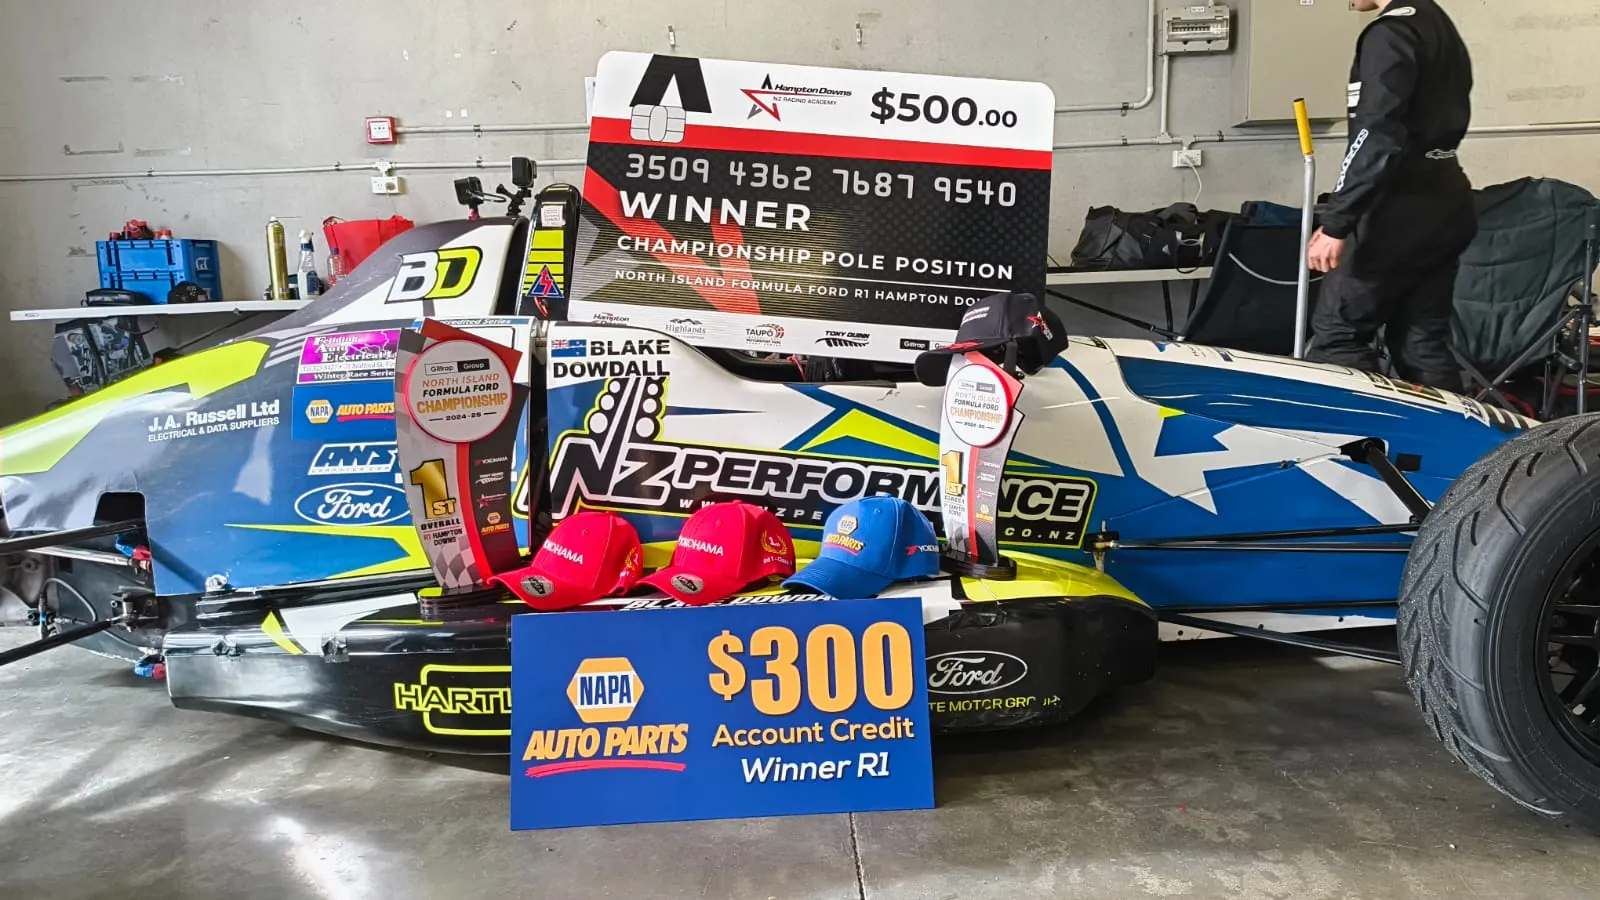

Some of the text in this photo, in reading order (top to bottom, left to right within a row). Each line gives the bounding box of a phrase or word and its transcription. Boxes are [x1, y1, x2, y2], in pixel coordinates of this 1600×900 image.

[774, 84, 852, 97] Hampton Downs
[870, 86, 1018, 128] $500.00
[626, 153, 1016, 207] 3509 4362 7687 9540
[619, 190, 811, 232] WINNER
[617, 235, 1013, 280] CHAMPIONSHIP POLE POSITION
[385, 246, 483, 304] BD
[615, 269, 665, 283] NORTH
[671, 273, 726, 288] ISLAND
[731, 278, 803, 294] FORMULA
[808, 285, 849, 298] FORD
[854, 289, 869, 299] R1
[875, 291, 949, 305] HAMPTON
[665, 323, 707, 335] Highlands
[590, 339, 670, 356] BLAKE
[422, 373, 500, 388] NORTH ISLAND
[553, 360, 670, 378] DOWDALL
[416, 392, 508, 414] CHAMPIONSHIP
[422, 382, 500, 398] FORMULA FORD
[186, 404, 247, 427] Russell
[251, 399, 281, 418] Ltd
[309, 406, 330, 418] NAPA
[336, 404, 364, 416] AUTO
[951, 406, 1004, 424] CHAMPIONSHIP
[954, 398, 1000, 411] FORMULA FORD
[148, 416, 281, 443] ELECTRICAL & DATA SUPPLIERS
[317, 489, 393, 519] Ford
[420, 518, 461, 530] OVERALL
[432, 528, 463, 538] HAMPTON
[433, 536, 457, 546] DOWNS
[707, 621, 915, 716] $300
[928, 656, 1005, 688] Ford
[580, 674, 632, 706] NAPA
[523, 722, 689, 762] AUTO PARTS
[712, 716, 915, 748] Account Credit
[741, 751, 890, 784] Winner R1
